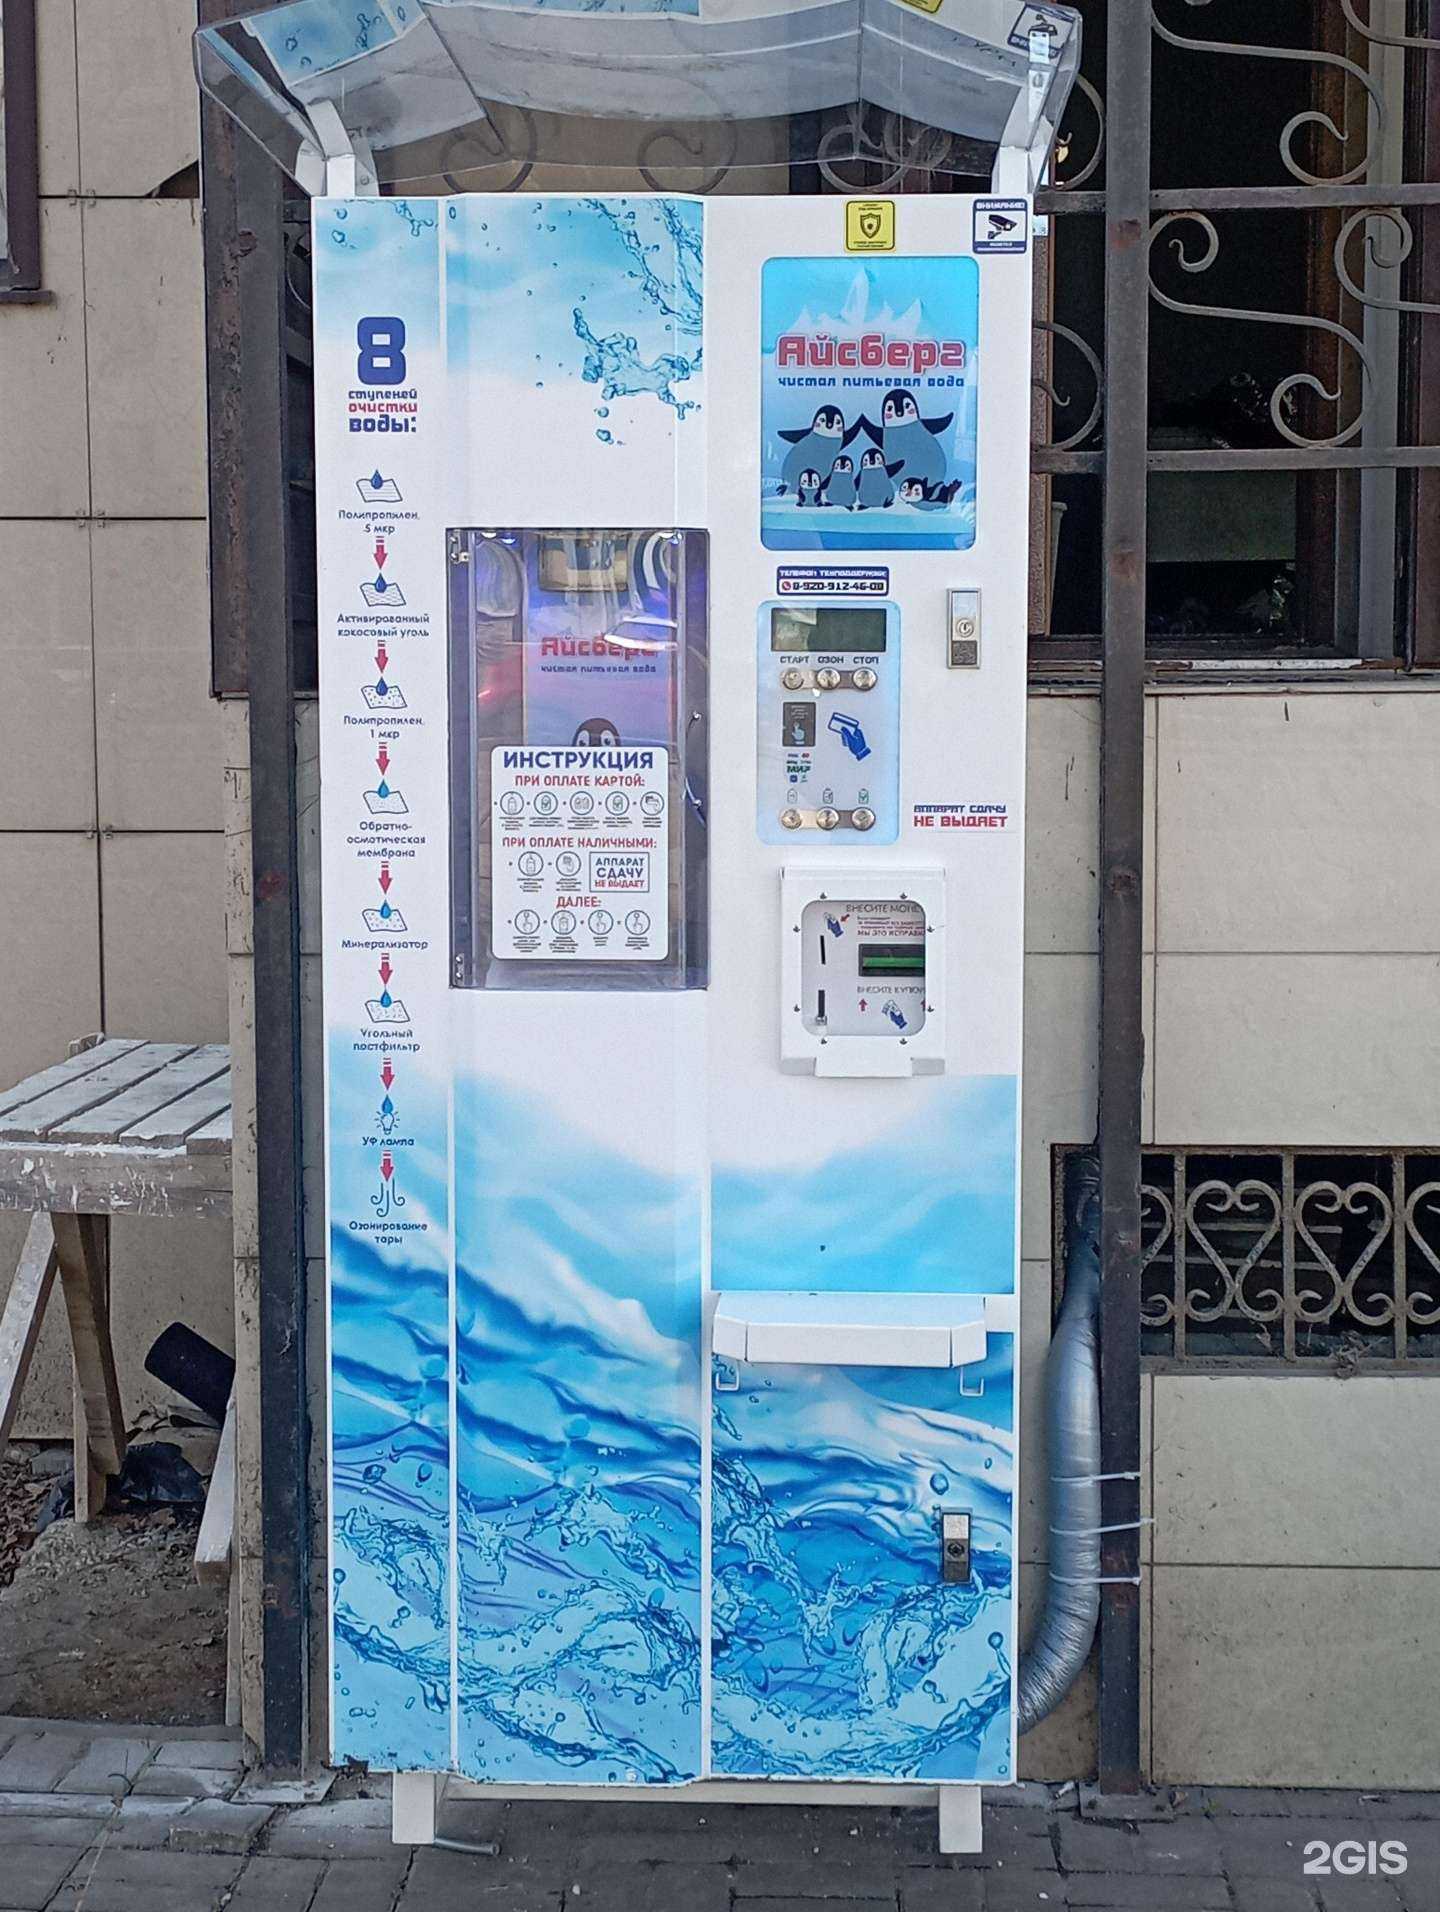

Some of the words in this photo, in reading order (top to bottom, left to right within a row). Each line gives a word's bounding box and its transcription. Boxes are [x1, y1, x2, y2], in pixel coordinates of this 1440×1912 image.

[357, 316, 406, 386] 8
[778, 333, 966, 375] Айсберг
[778, 376, 836, 387] чистая
[842, 376, 921, 387] питьевая
[927, 374, 965, 387] вода
[348, 388, 418, 401] ступеней
[348, 402, 418, 413] очистки
[349, 413, 417, 433] воды:
[374, 525, 395, 535] мкр
[337, 613, 430, 625] Активированный
[337, 627, 397, 637] кокосовый
[400, 628, 430, 638] уголь
[780, 655, 809, 664] СТАРТ
[817, 655, 845, 664] ОЗОН
[852, 655, 880, 665] СТОП
[369, 729, 374, 738] 1
[378, 730, 400, 740] мкр
[503, 750, 654, 772] ИНСТРУКЦИЯ
[514, 775, 540, 787] ПРИ
[543, 775, 591, 787] ОПЛАТЕ
[594, 773, 645, 787] КАРТОЙ:
[969, 804, 1007, 814] СДАЧУ
[359, 821, 413, 832] Обратно-
[913, 815, 935, 827] НЕ
[940, 815, 1008, 827] ВЫДАЕТ
[346, 836, 426, 844] осмотическая
[502, 837, 526, 848] ПРИ
[529, 837, 574, 848] ОПЛАТЕ
[577, 837, 657, 849] НАЛИЧНЫМИ:
[357, 848, 416, 859] мембрана
[595, 857, 645, 867] АППАРАТ
[596, 868, 644, 880] СДАЧУ
[594, 879, 606, 888] НЕ
[608, 879, 645, 888] ВЫДАЕТ
[341, 940, 429, 950] Минерализатор
[360, 1028, 413, 1038] Угольный
[353, 1041, 421, 1052] постфильтр
[362, 1136, 378, 1146] УФ
[380, 1138, 415, 1146] лампа
[349, 1220, 428, 1232] Озонирование
[374, 1235, 403, 1245] тары
